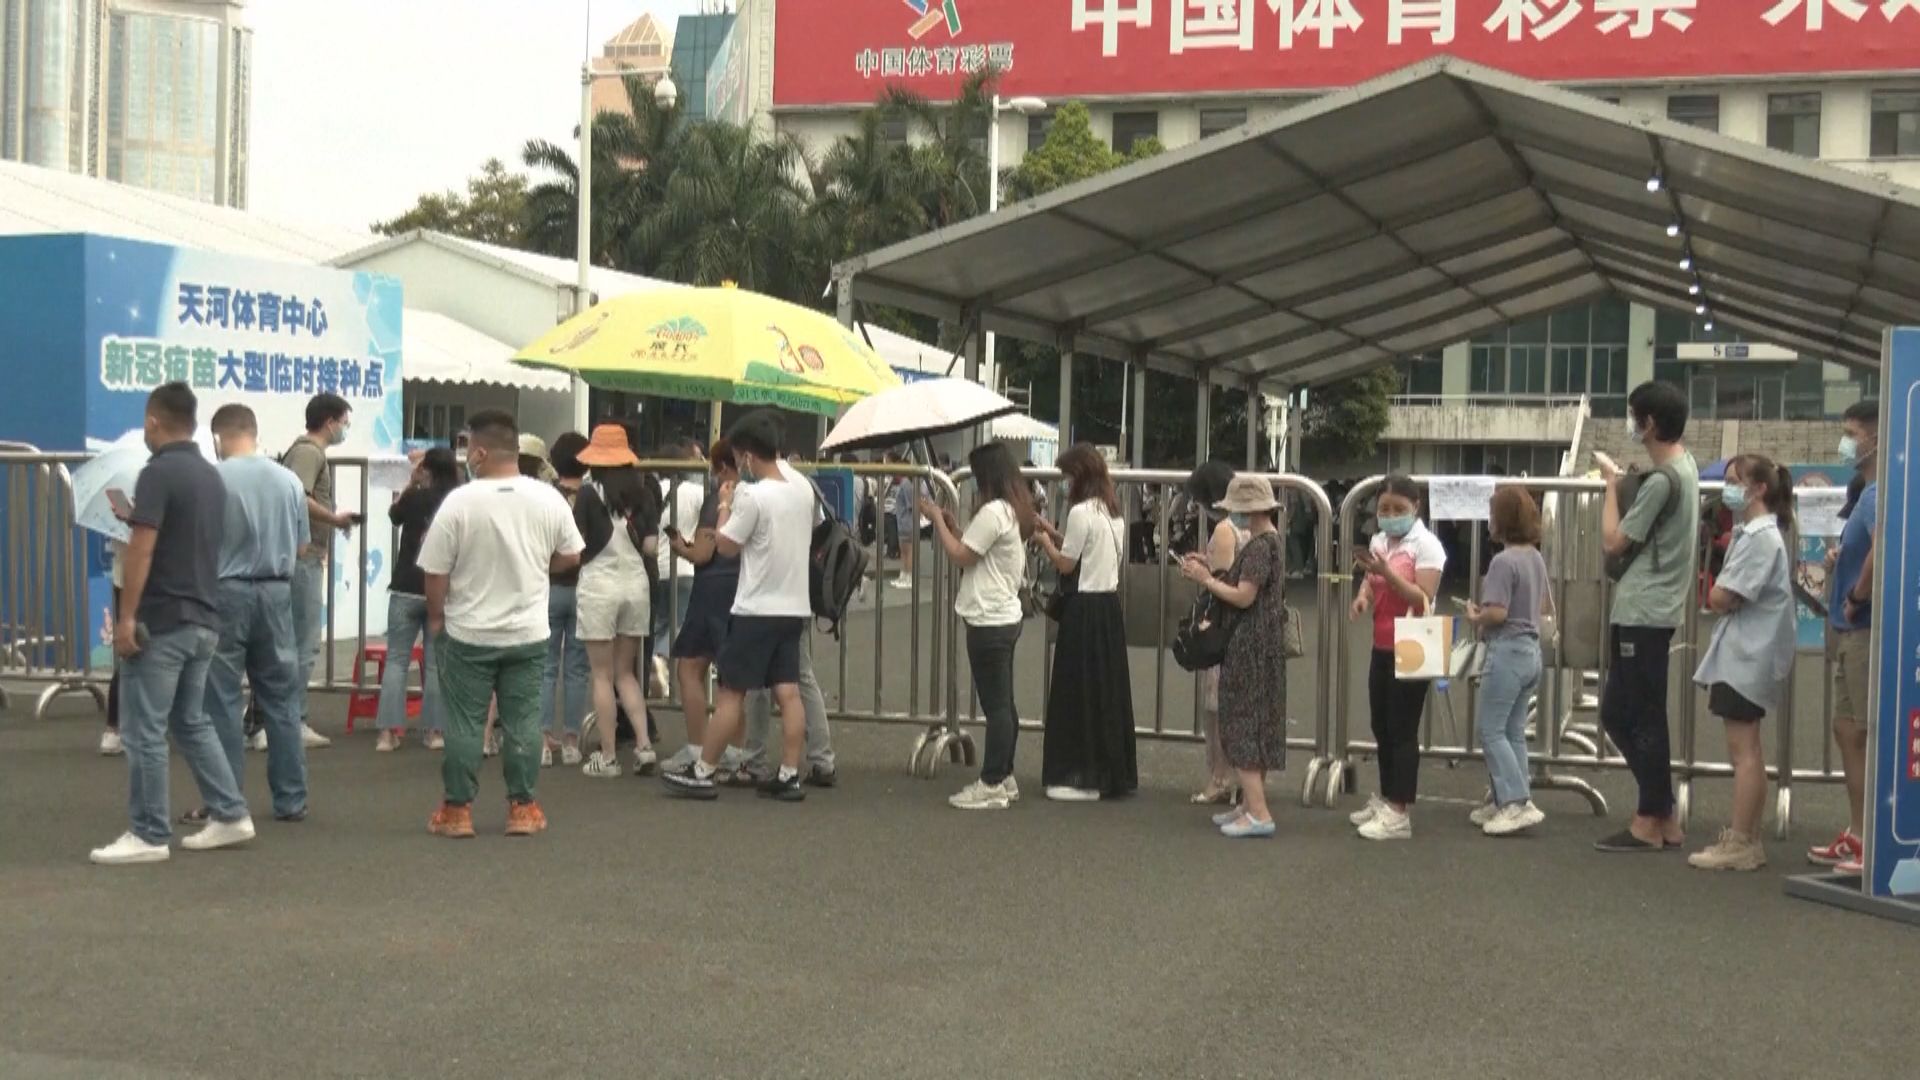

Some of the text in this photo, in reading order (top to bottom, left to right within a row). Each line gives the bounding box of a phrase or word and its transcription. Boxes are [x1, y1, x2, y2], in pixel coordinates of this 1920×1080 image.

[855, 41, 1014, 78] 中国体育彩票
[178, 283, 328, 337] 天河体育中心
[104, 338, 384, 398] 新冠疫苗大型临时接种点
